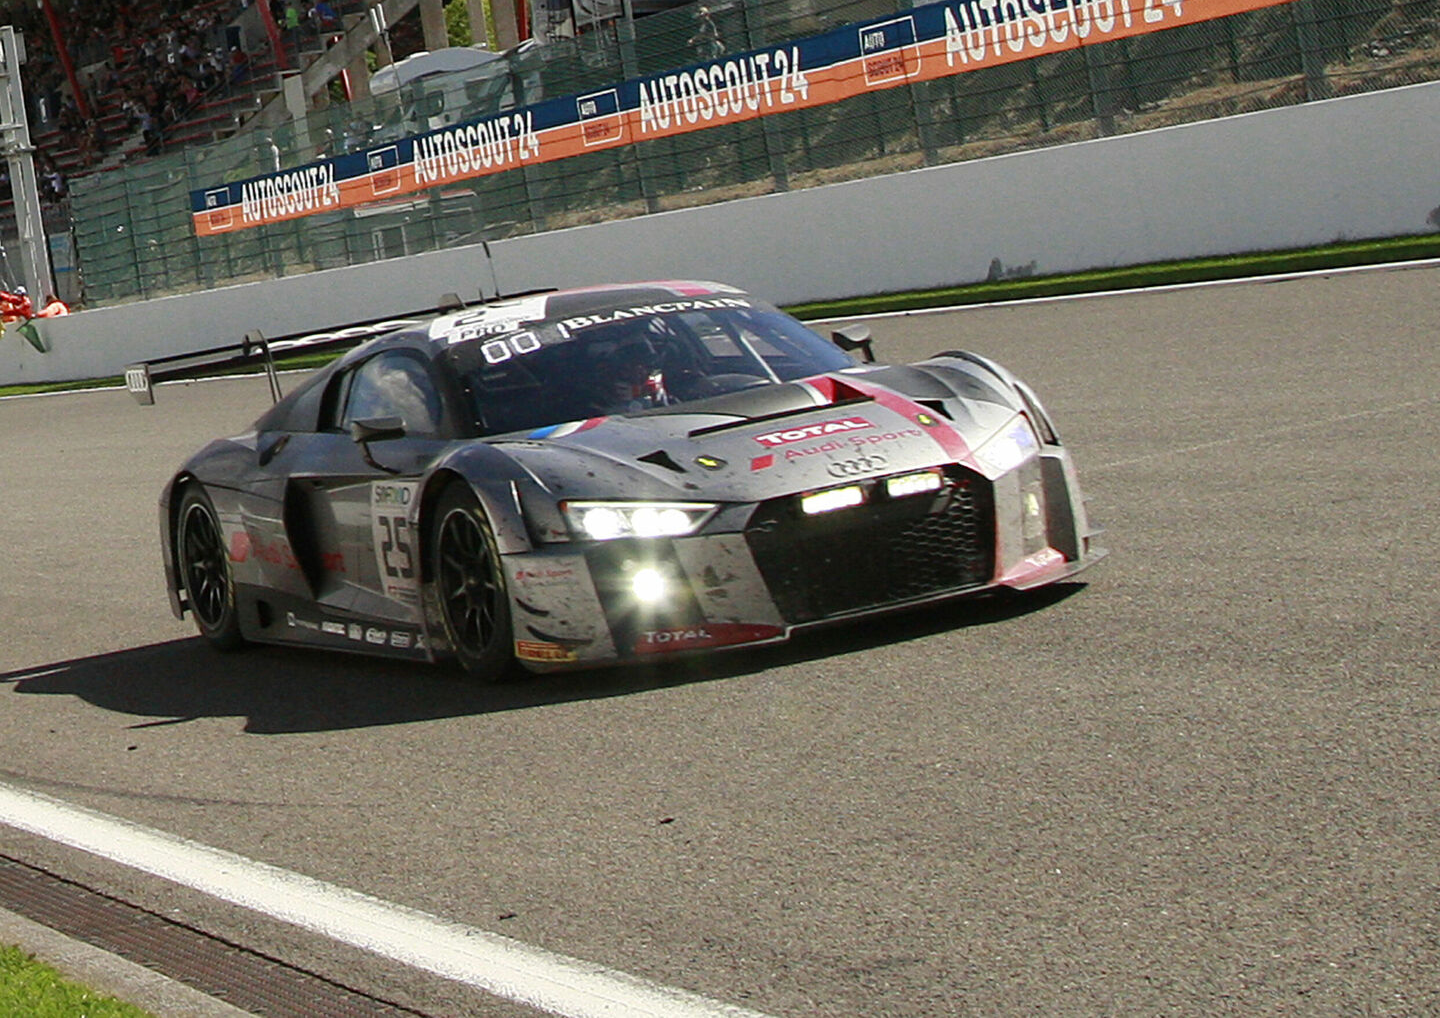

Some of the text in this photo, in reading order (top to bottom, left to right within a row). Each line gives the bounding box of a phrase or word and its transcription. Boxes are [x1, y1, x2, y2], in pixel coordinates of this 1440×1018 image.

[639, 46, 810, 134] AUTOSCOUT 24
[564, 297, 752, 331] BLANCPAIN
[757, 420, 870, 445] TOTAL
[784, 430, 922, 460] Audi Sport
[644, 628, 712, 644] TOTAL
